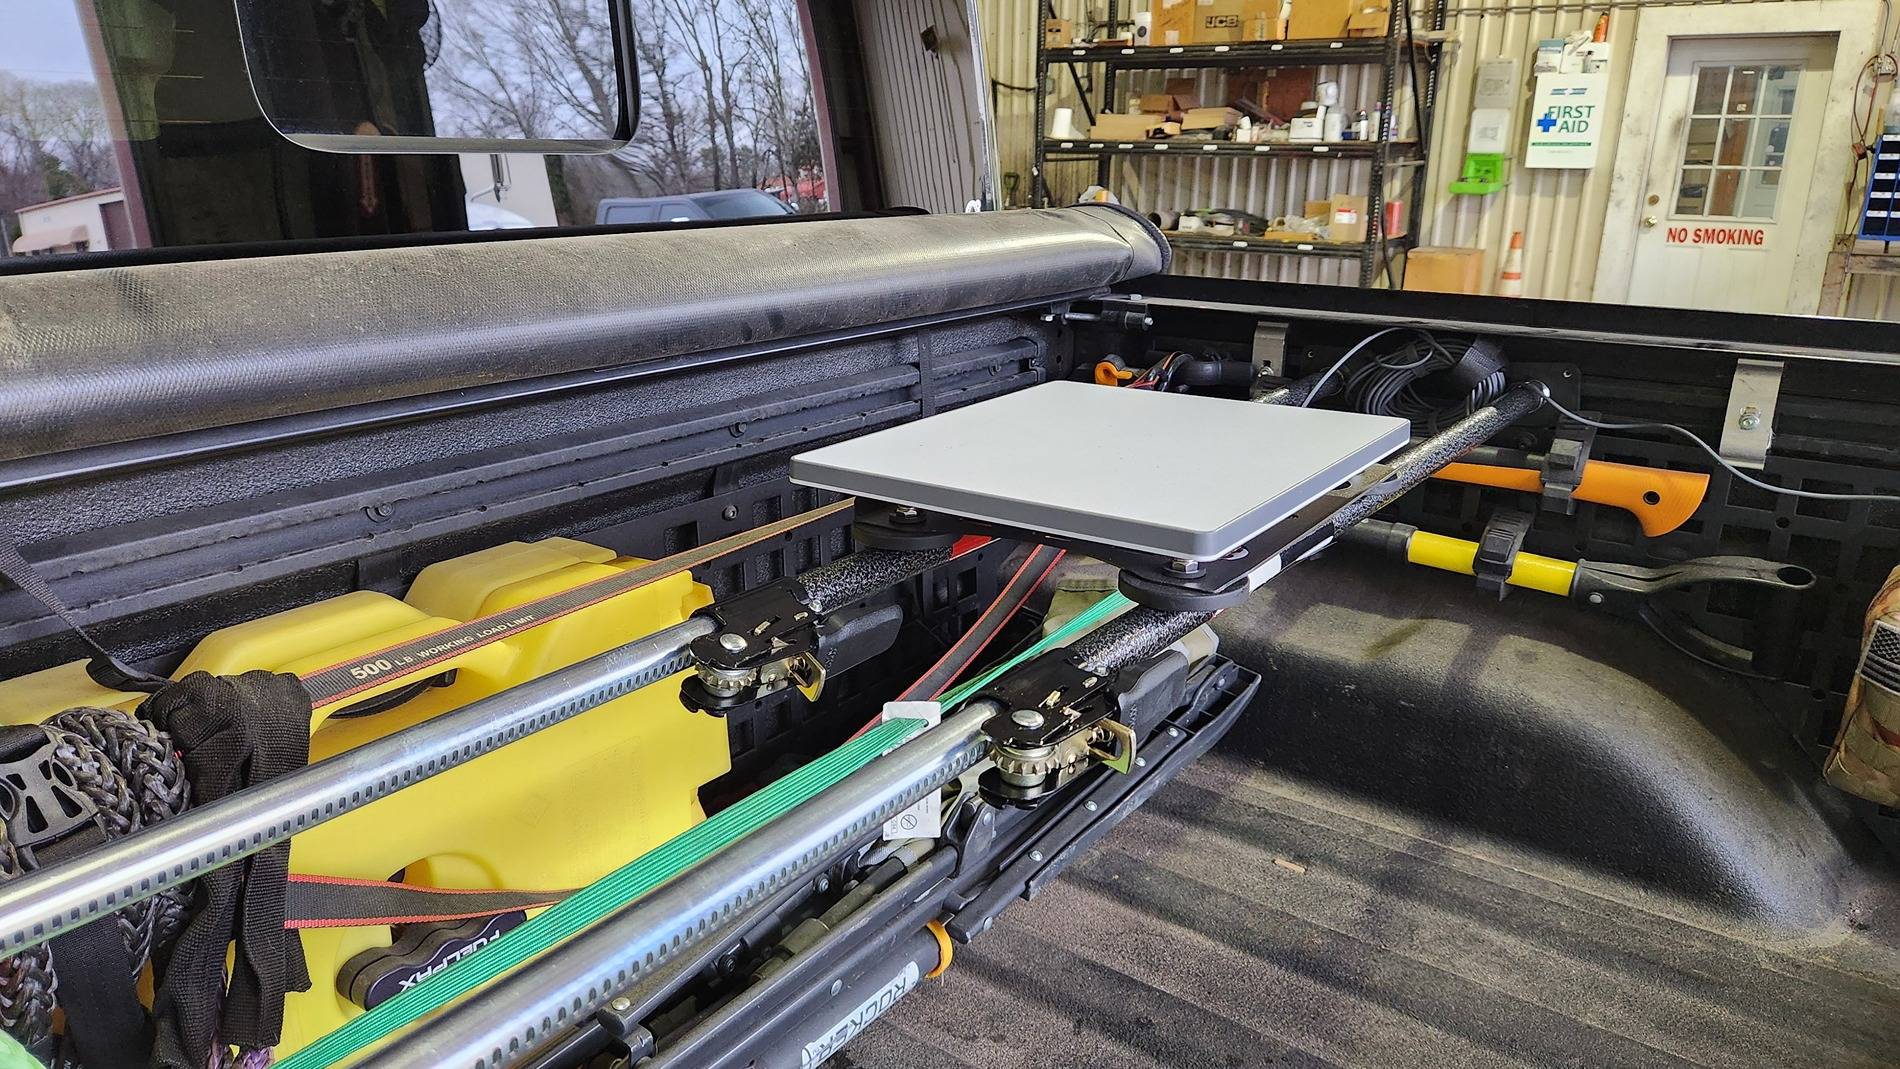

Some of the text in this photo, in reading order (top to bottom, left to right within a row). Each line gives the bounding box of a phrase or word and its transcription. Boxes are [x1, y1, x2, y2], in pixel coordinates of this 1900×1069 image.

[1205, 15, 1239, 28] JCB
[1548, 105, 1596, 119] FIRST
[1558, 120, 1589, 133] AID
[1666, 227, 1765, 246] NO SMOKING
[351, 614, 535, 679] 500 LB WORKING LOAD LIMIT
[818, 976, 906, 1063] ROCKER
